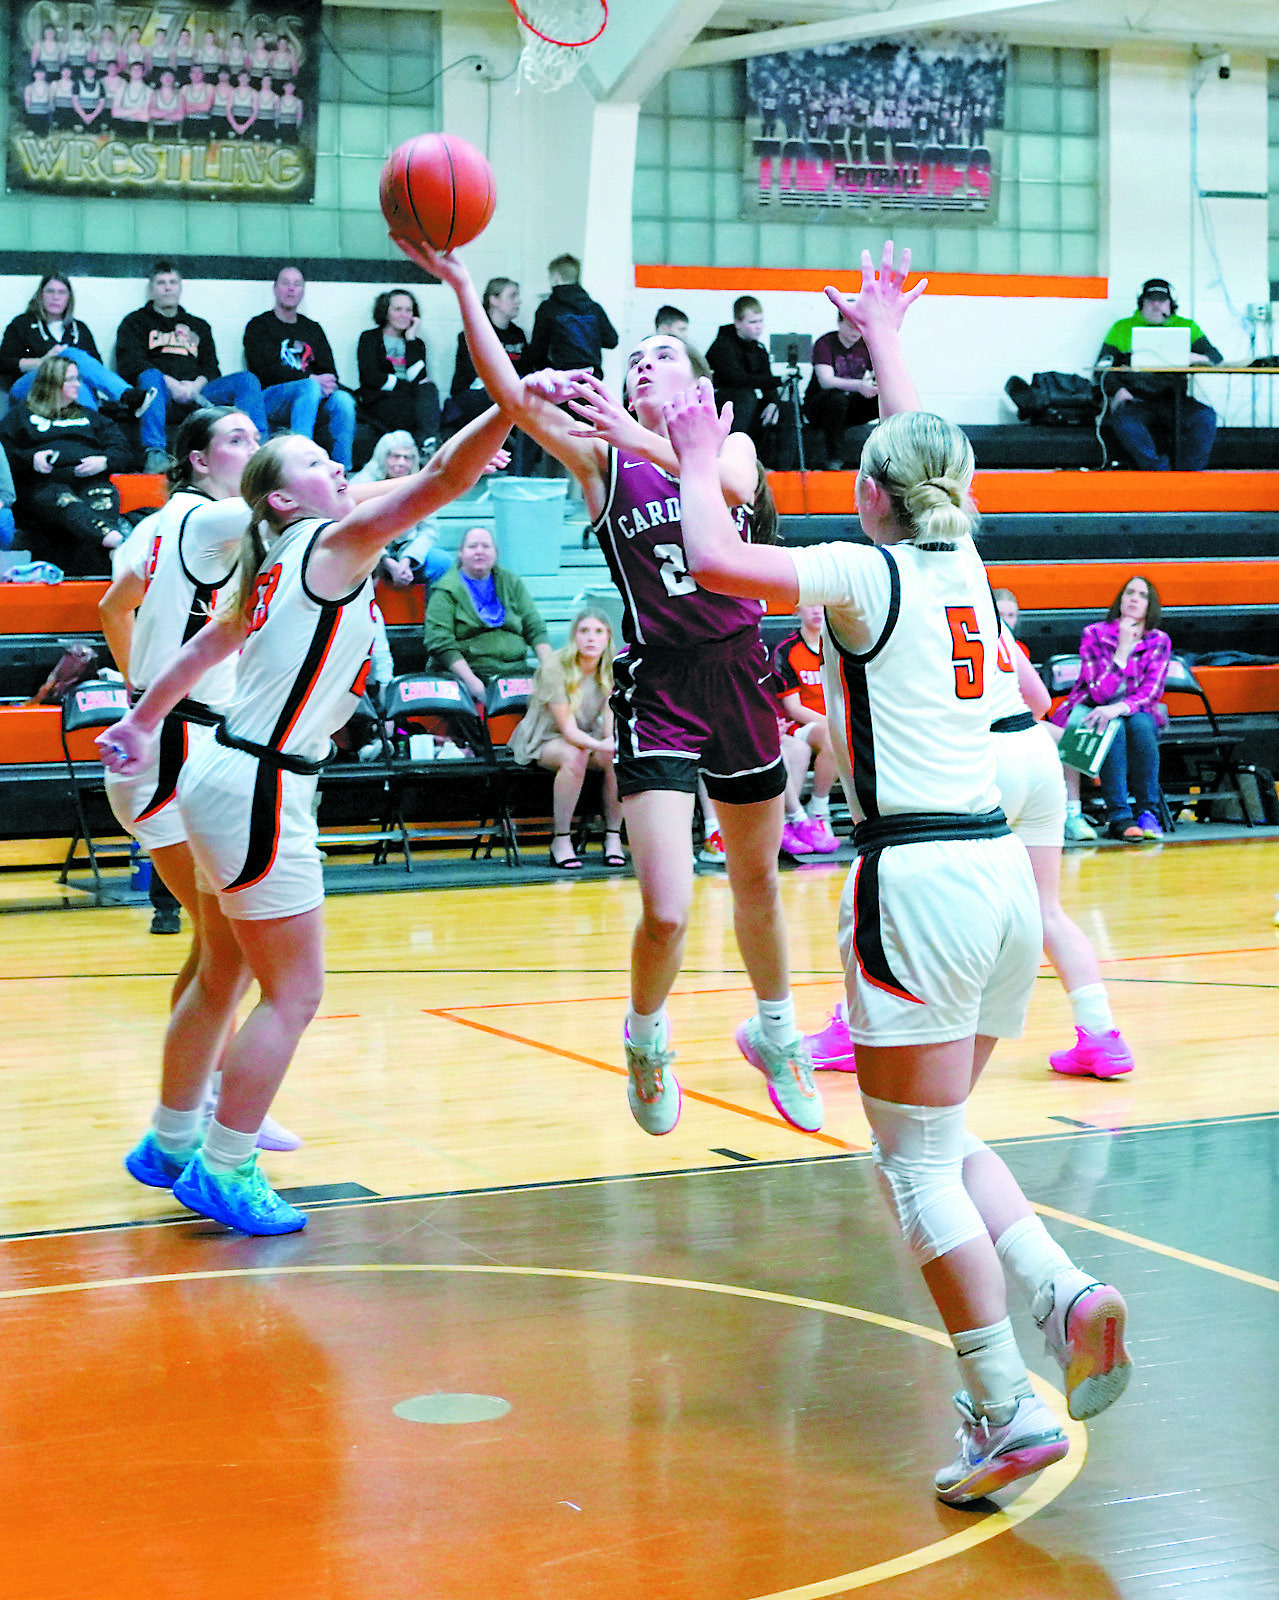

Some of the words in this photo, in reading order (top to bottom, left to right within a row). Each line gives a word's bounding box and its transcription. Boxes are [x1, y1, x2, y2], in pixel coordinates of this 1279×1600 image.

[19, 137, 304, 187] WRESTLING
[617, 497, 745, 540] CARDS
[652, 543, 697, 597] 2
[944, 605, 984, 699] 5
